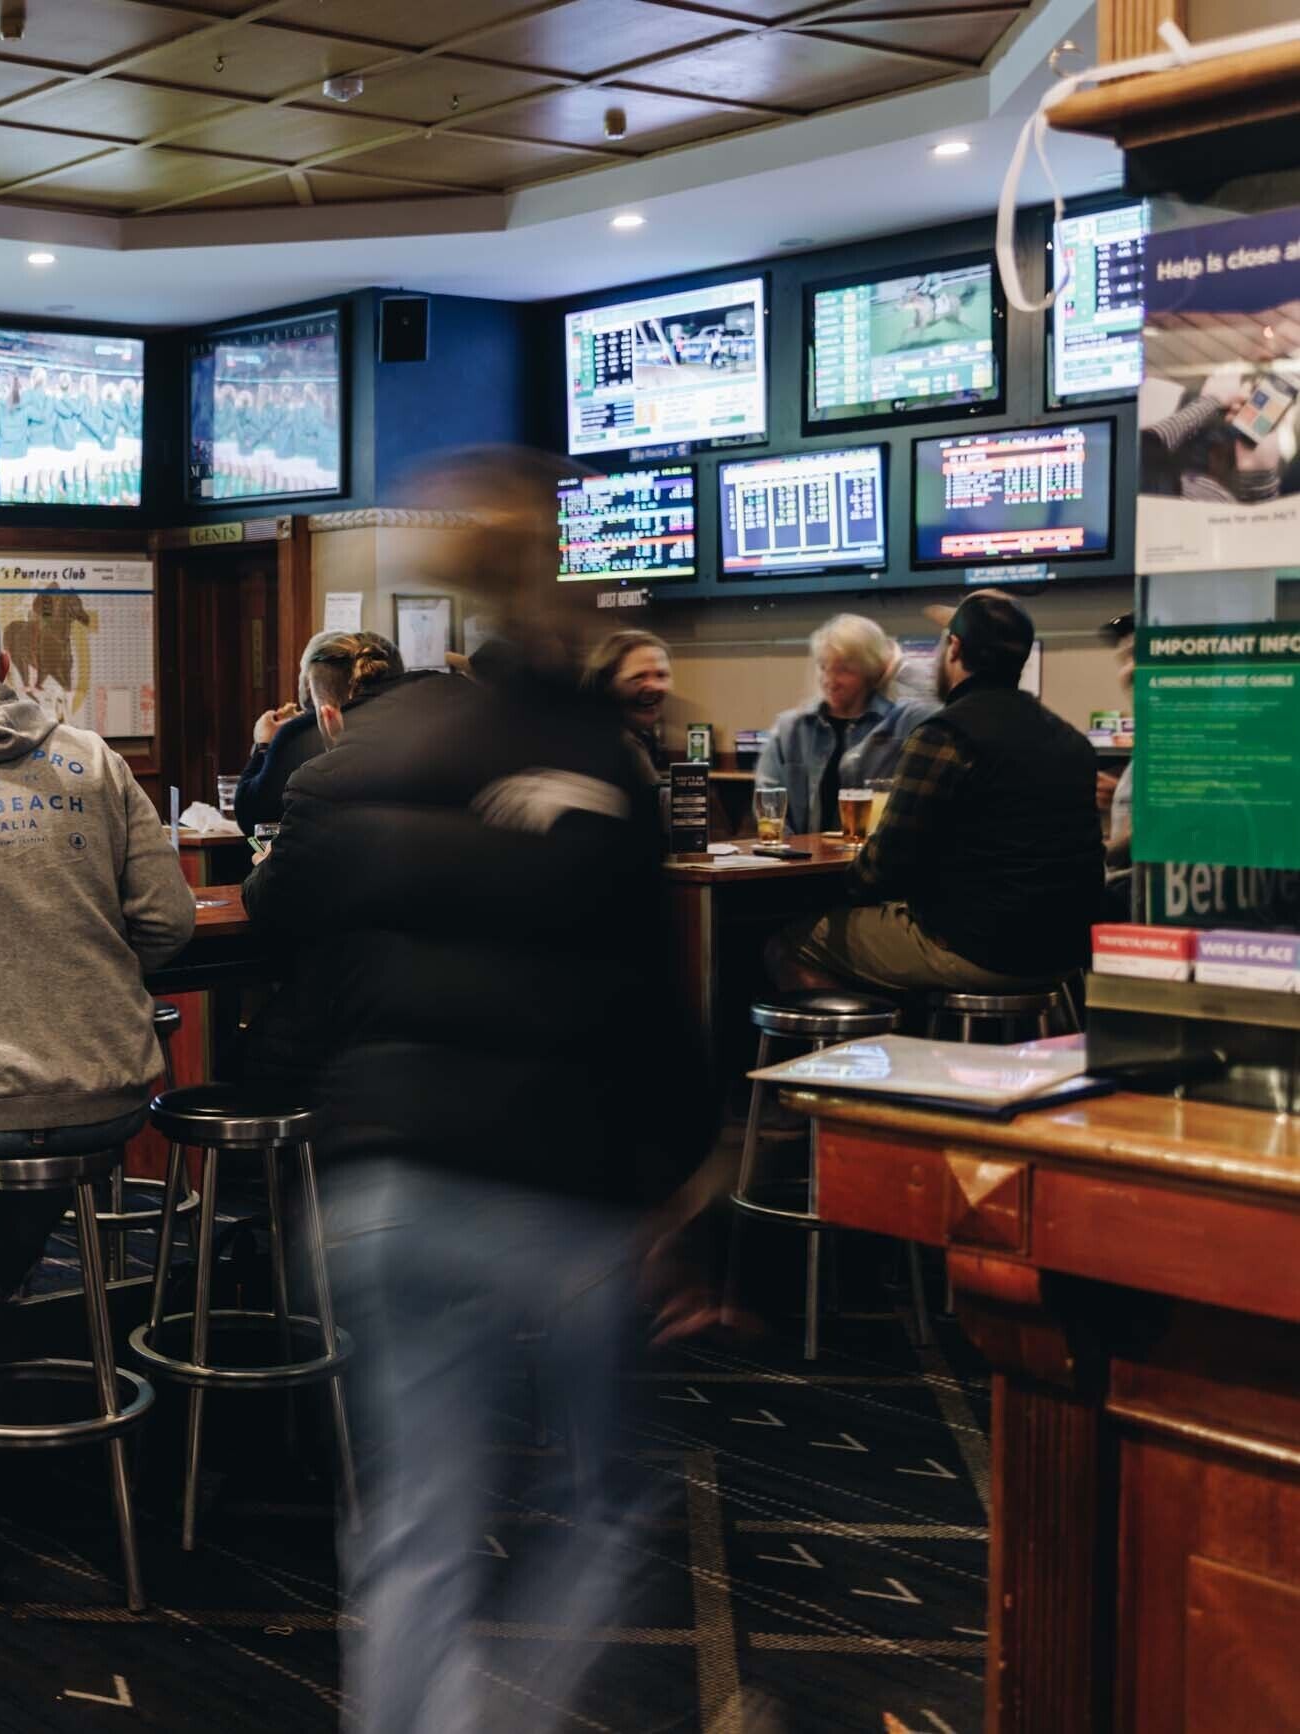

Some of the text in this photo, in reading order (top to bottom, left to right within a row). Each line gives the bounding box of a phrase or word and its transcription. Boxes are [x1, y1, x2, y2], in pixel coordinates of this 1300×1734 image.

[1157, 257, 1203, 281] Help
[1207, 250, 1223, 273] is
[1226, 244, 1280, 270] close
[195, 527, 237, 543] GENTS
[13, 567, 58, 580] Punters
[62, 566, 87, 580] Club
[1150, 636, 1256, 656] IMPORTANT
[1149, 674, 1294, 688] A MINOR MUST NOT GAMBLE
[31, 748, 85, 776] PRO
[1164, 861, 1227, 917] Bet
[1201, 941, 1232, 957] WIN
[1249, 943, 1293, 962] PLACE
